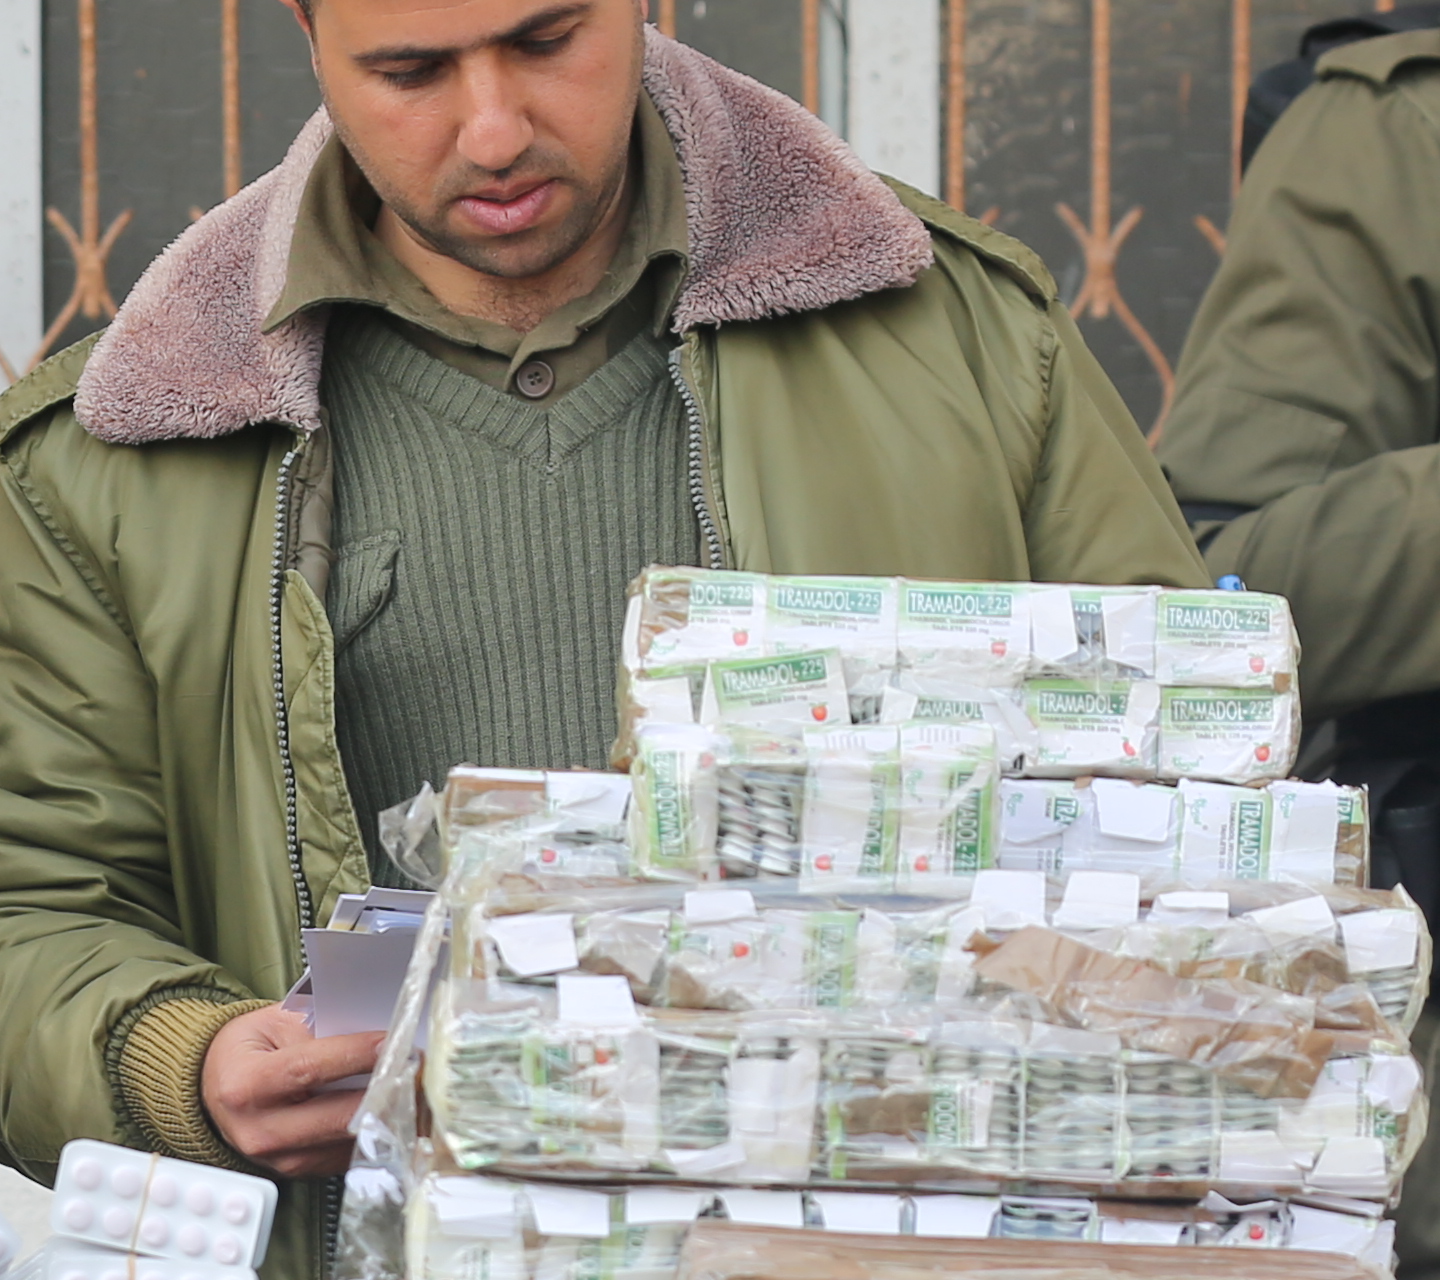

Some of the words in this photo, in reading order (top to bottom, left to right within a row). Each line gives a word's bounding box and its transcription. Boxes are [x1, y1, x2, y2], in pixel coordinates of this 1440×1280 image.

[690, 583, 752, 605] ADOL-225
[779, 586, 881, 613] TRAMADOL-225
[909, 590, 1010, 616] TRAMADOL-225
[1168, 608, 1270, 630] TRAMADOL-225
[724, 656, 826, 692] TRAMADOL-225
[1039, 691, 1127, 714] TRAMADOL-2
[1173, 699, 1272, 720] TRAMADOL-225
